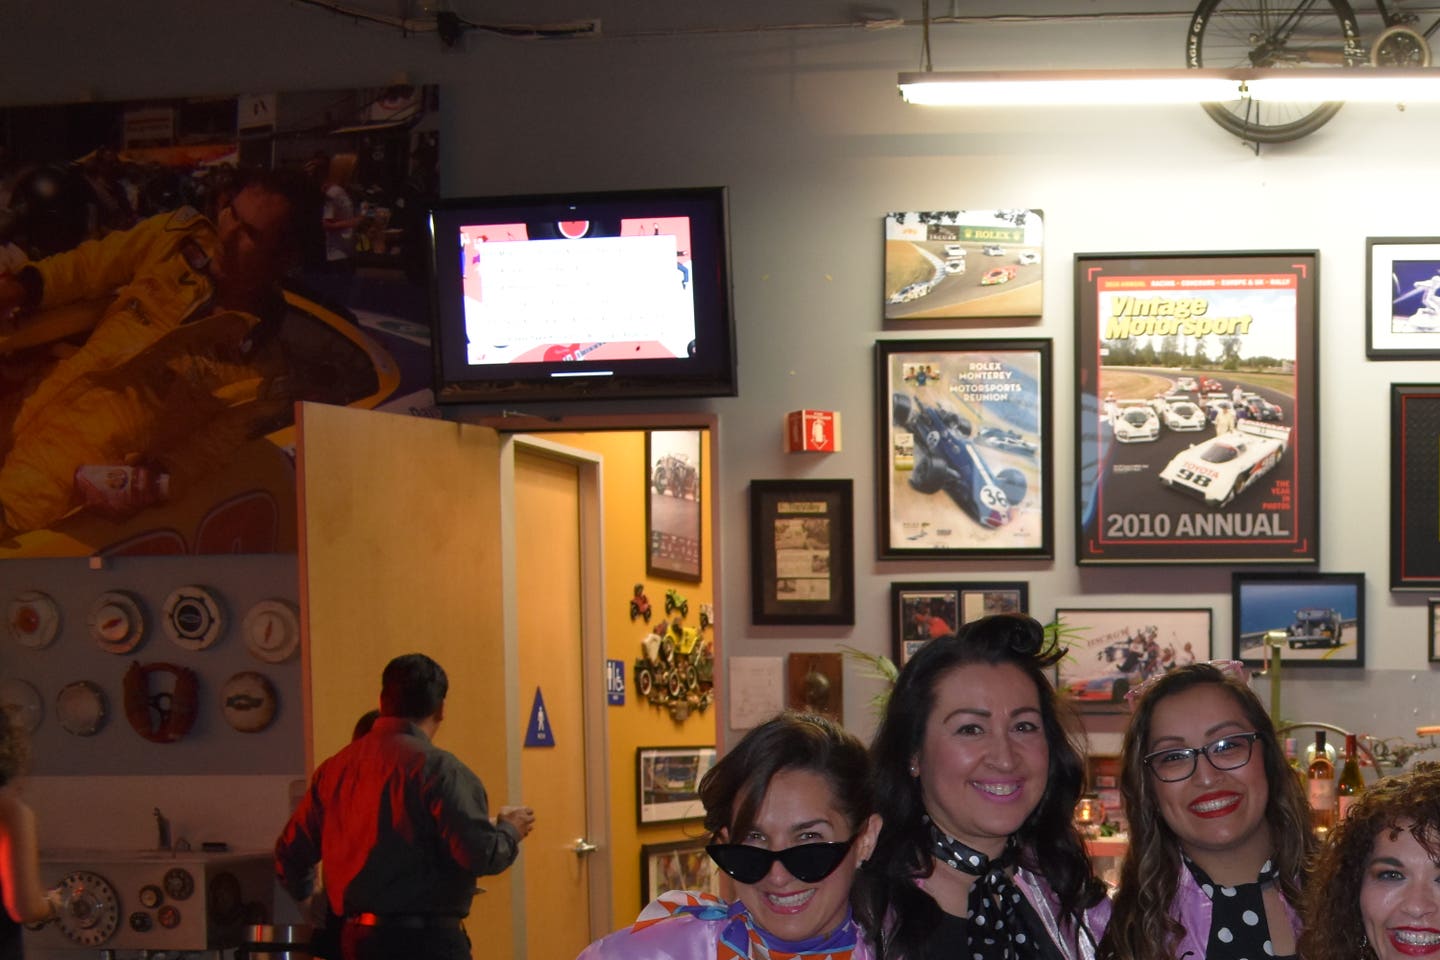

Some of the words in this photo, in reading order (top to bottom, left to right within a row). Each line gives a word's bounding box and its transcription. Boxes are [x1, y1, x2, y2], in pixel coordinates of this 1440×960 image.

[975, 229, 1010, 239] ROLEX
[1111, 295, 1209, 320] Vintage
[1104, 314, 1253, 340] Motorsport
[969, 362, 1002, 371] ROLEX
[958, 371, 1012, 380] MONTEREY
[949, 383, 1022, 393] MOTORSPORTS
[963, 393, 1009, 402] REUNION
[1183, 461, 1220, 479] TOYOTA
[1176, 468, 1213, 488] 98
[984, 488, 1008, 508] 36
[1262, 502, 1291, 510] PHOTOS
[1107, 513, 1171, 538] 2010
[1175, 513, 1290, 537] ANNUAL
